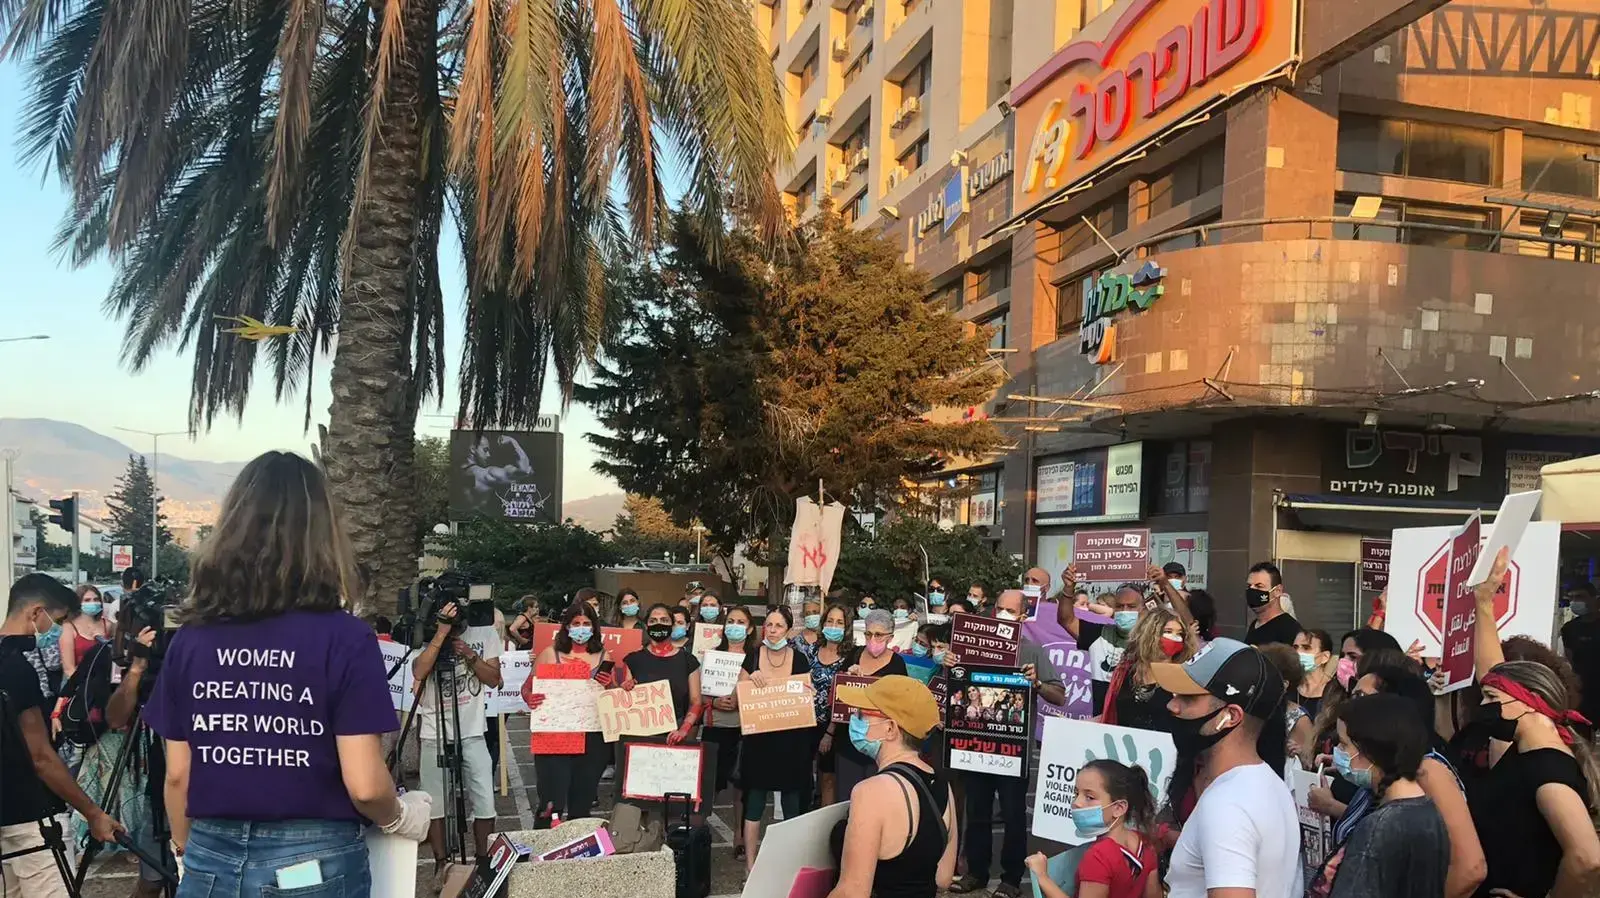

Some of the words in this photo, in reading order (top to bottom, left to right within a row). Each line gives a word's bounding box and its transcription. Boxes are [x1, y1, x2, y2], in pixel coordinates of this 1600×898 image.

[1070, 0, 1263, 160] שופרסל
[1115, 464, 1133, 477] מפגש
[1108, 483, 1138, 495] הפירמידה
[1330, 479, 1384, 494] לילדים
[1388, 482, 1436, 497] אופנה
[1087, 537, 1123, 547] שותקות
[1125, 536, 1139, 545] לא
[1076, 551, 1101, 560] הרצח
[1104, 551, 1131, 560] ניסיון
[1133, 550, 1147, 558] על
[964, 621, 997, 633] שותקות
[999, 627, 1011, 635] לא
[953, 633, 976, 644] הרצח
[978, 638, 1003, 648] ניסיון
[965, 648, 979, 656] רמון
[1005, 642, 1017, 651] על
[216, 648, 295, 668] WOMEN
[192, 681, 293, 701] CREATING
[298, 687, 314, 705] A
[751, 684, 786, 696] שותקות
[771, 698, 796, 708] ניסיון
[798, 695, 811, 704] על
[742, 702, 768, 711] הרצח
[192, 713, 248, 732] AFER
[253, 714, 324, 736] WORLD
[950, 737, 996, 753] שלישי
[1000, 743, 1022, 756] יום
[197, 745, 310, 768] TOGETHER
[1046, 763, 1077, 782] STO
[1045, 780, 1075, 794] VIOLEN
[1043, 803, 1073, 819] WOME
